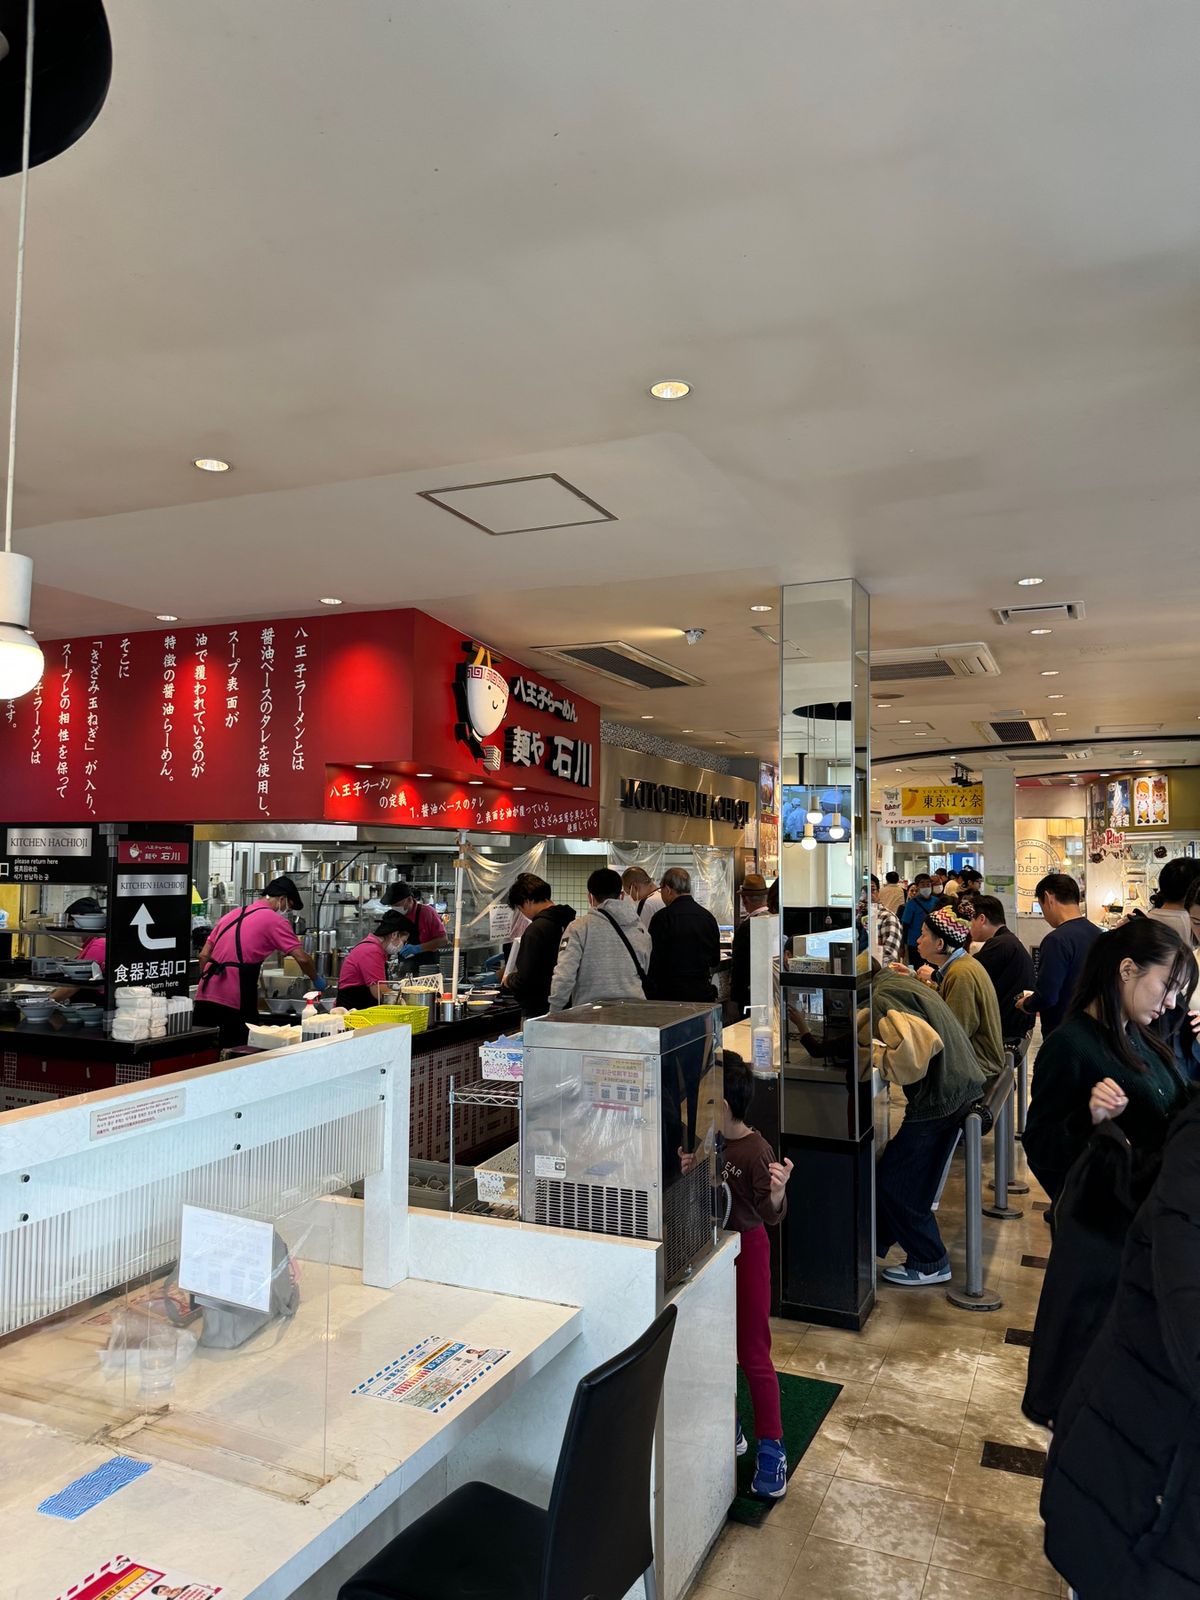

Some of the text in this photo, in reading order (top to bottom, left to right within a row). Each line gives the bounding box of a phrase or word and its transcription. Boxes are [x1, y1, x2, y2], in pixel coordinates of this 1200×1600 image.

[118, 638, 131, 678] そこに
[225, 630, 240, 729] スープ表面が
[31, 680, 44, 764] 子ラーメンは
[56, 643, 73, 799] スープとの相性を保って
[160, 635, 177, 782] 特徴の醤油らーめん。
[191, 633, 208, 779] 油で覆われているのが
[256, 627, 275, 816] 醤油ベースのタレを使用し、
[292, 627, 309, 771] 八王子ラーメンとは
[514, 676, 579, 723] 八王子らーめん
[552, 735, 593, 788] 石川
[329, 777, 392, 798] 八王子ラーメン
[379, 791, 407, 809] の定義
[922, 794, 983, 809] 東京ばな奈
[10, 837, 88, 849] KITCHEN HACHIOJI
[120, 881, 185, 891] KITCHEN HACHIOJI
[114, 960, 187, 983] 食器返却口
[165, 980, 179, 988] here
